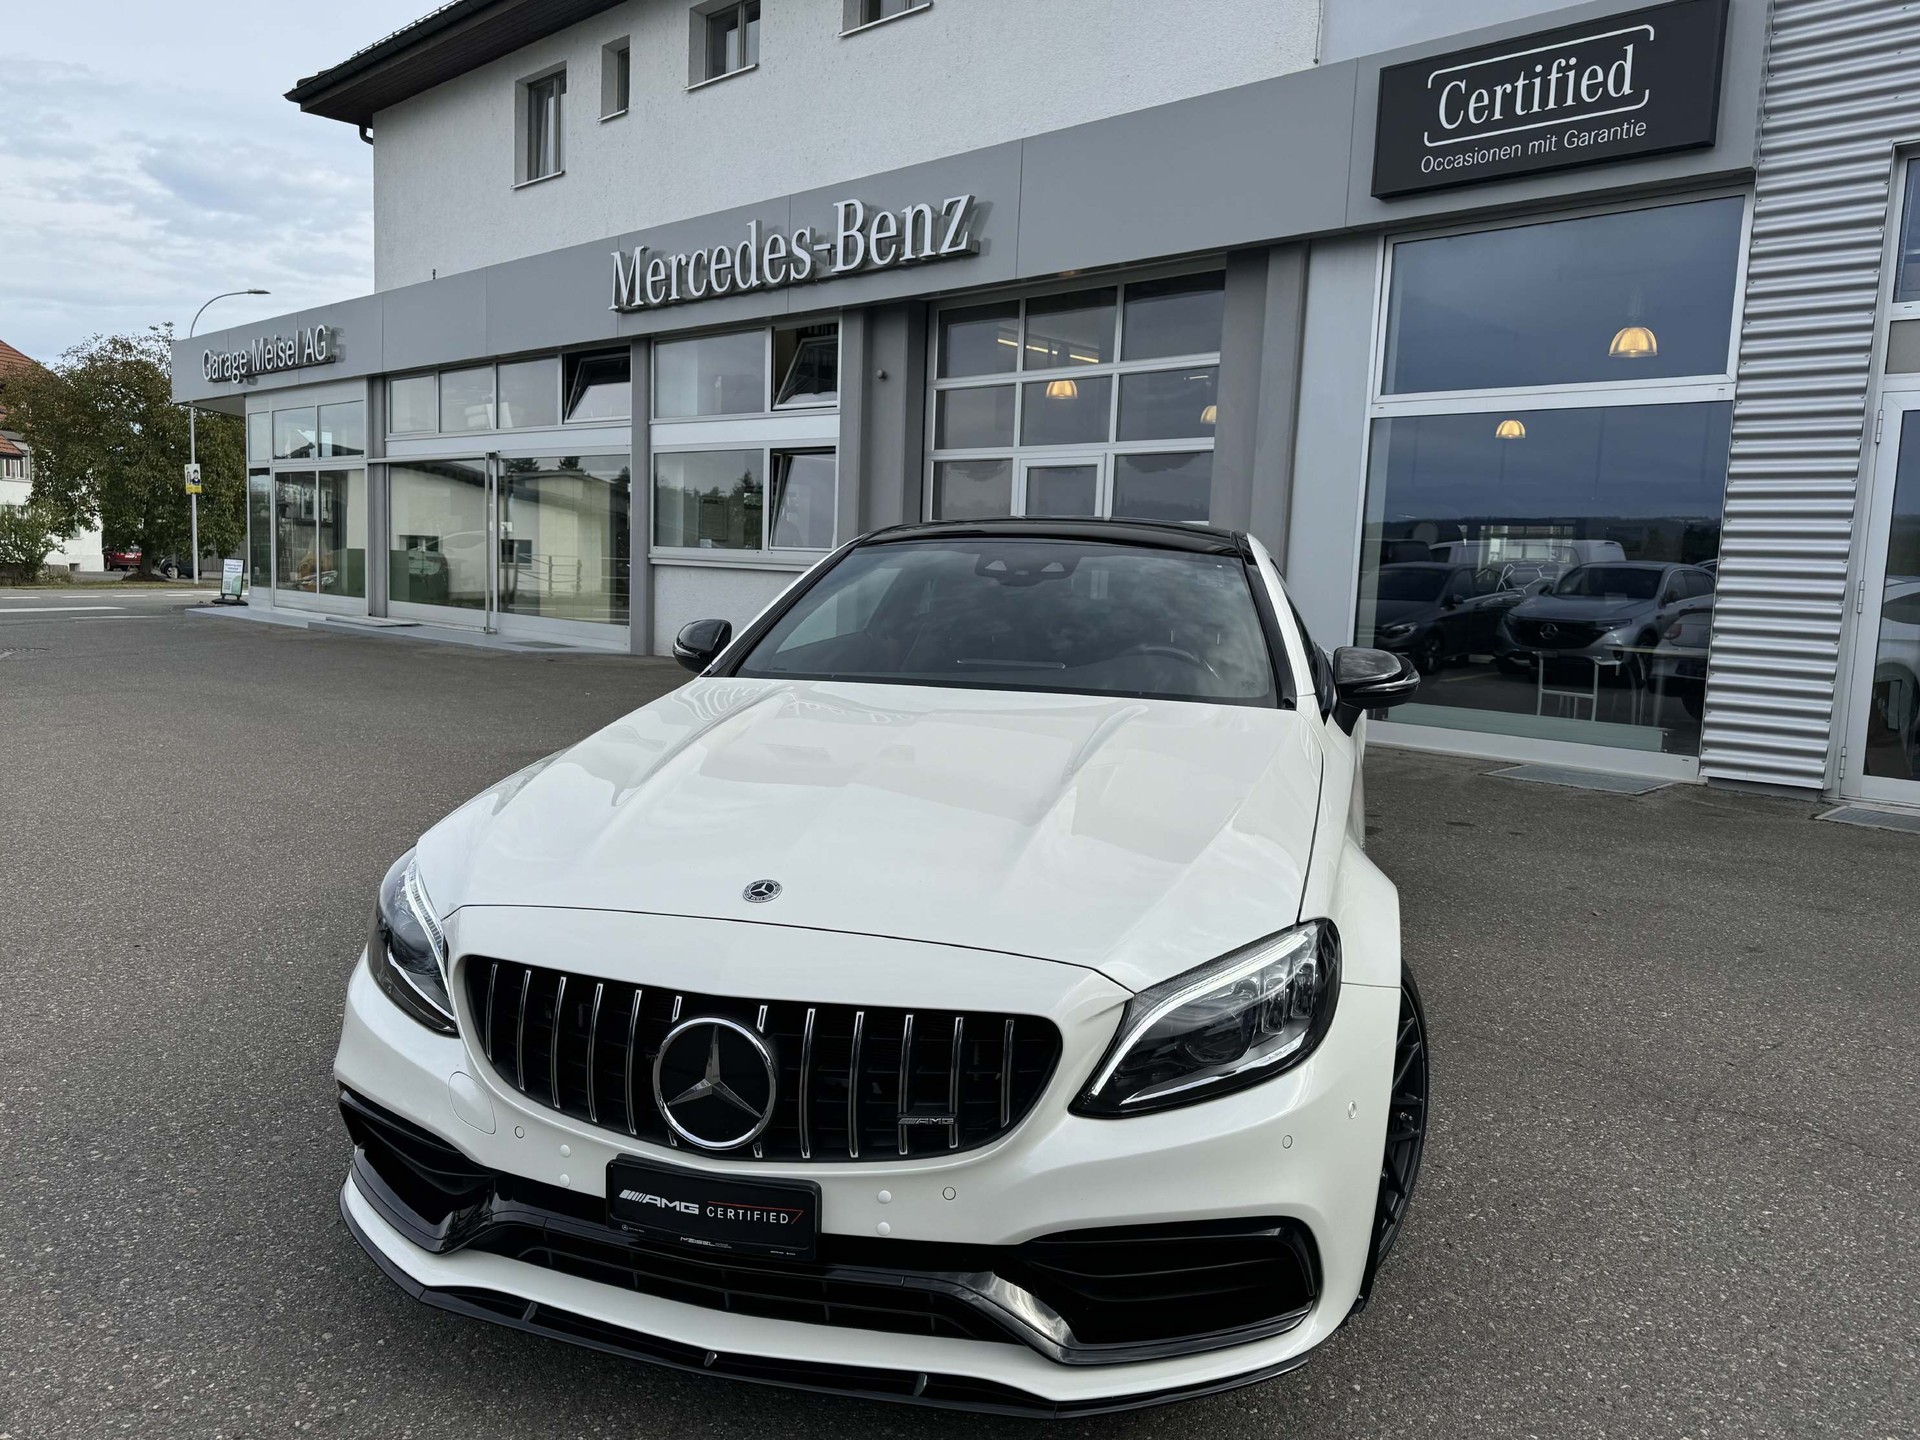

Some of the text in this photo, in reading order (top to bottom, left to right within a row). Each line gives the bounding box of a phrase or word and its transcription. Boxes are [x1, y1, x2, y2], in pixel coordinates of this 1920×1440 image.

[1438, 43, 1634, 130] Certified
[1420, 120, 1647, 173] Occasionen mit Garantie
[609, 194, 976, 311] Mercedes-Benz
[202, 324, 327, 384] Garage Meisel AG
[912, 1117, 955, 1125] AMG
[640, 1193, 789, 1224] AMG CERTIFIED
